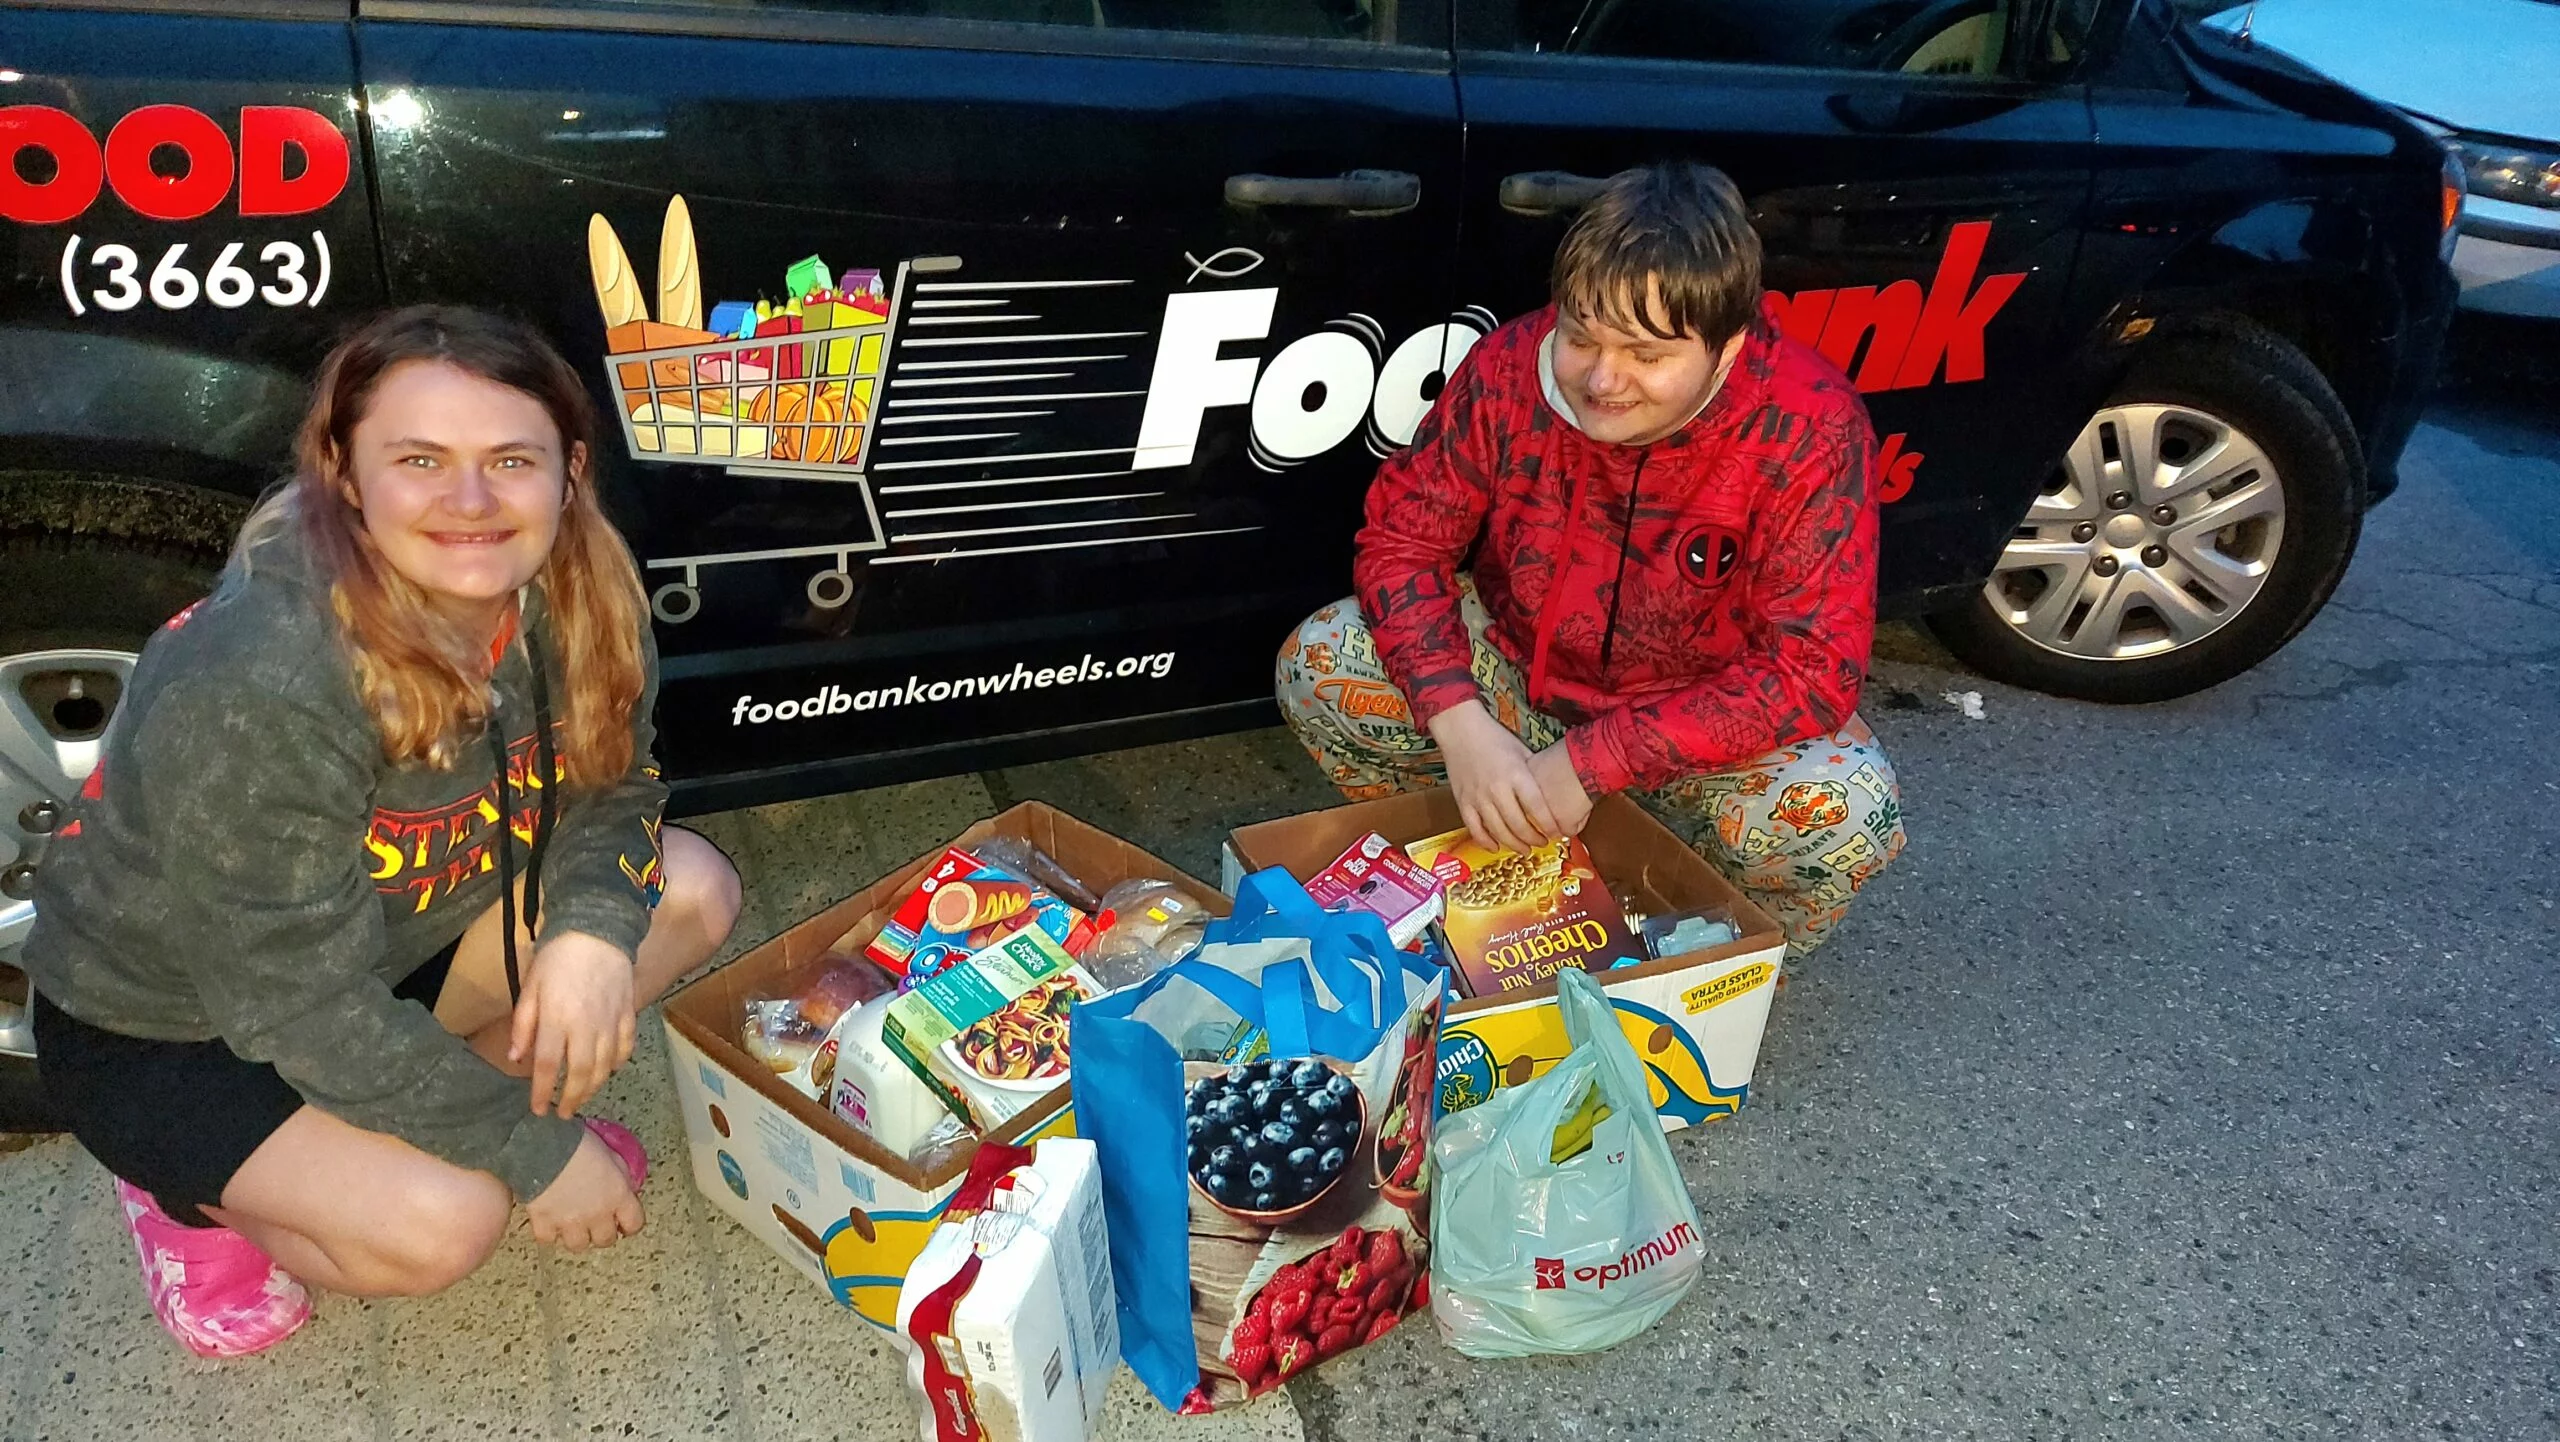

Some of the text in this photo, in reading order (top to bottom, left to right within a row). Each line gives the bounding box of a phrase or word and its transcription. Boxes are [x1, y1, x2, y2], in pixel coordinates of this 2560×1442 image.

[60, 230, 331, 317] (3663)
[1132, 285, 1486, 472] Foo
[1470, 638, 1500, 690] H
[731, 650, 1175, 726] foodbankonwheels.org
[1314, 678, 1408, 723] Tigers
[1847, 761, 1890, 804] H
[1818, 831, 1877, 872] H
[1011, 943, 1042, 972] Choice
[1022, 942, 1048, 968] Healthy
[1484, 919, 1609, 974] Cheerios
[1498, 971, 1533, 992] Nut
[1689, 975, 1764, 1012] SELECTED QUALITY
[1691, 965, 1762, 1001] CLASS EXTRA
[1573, 1221, 1700, 1290] optimum
